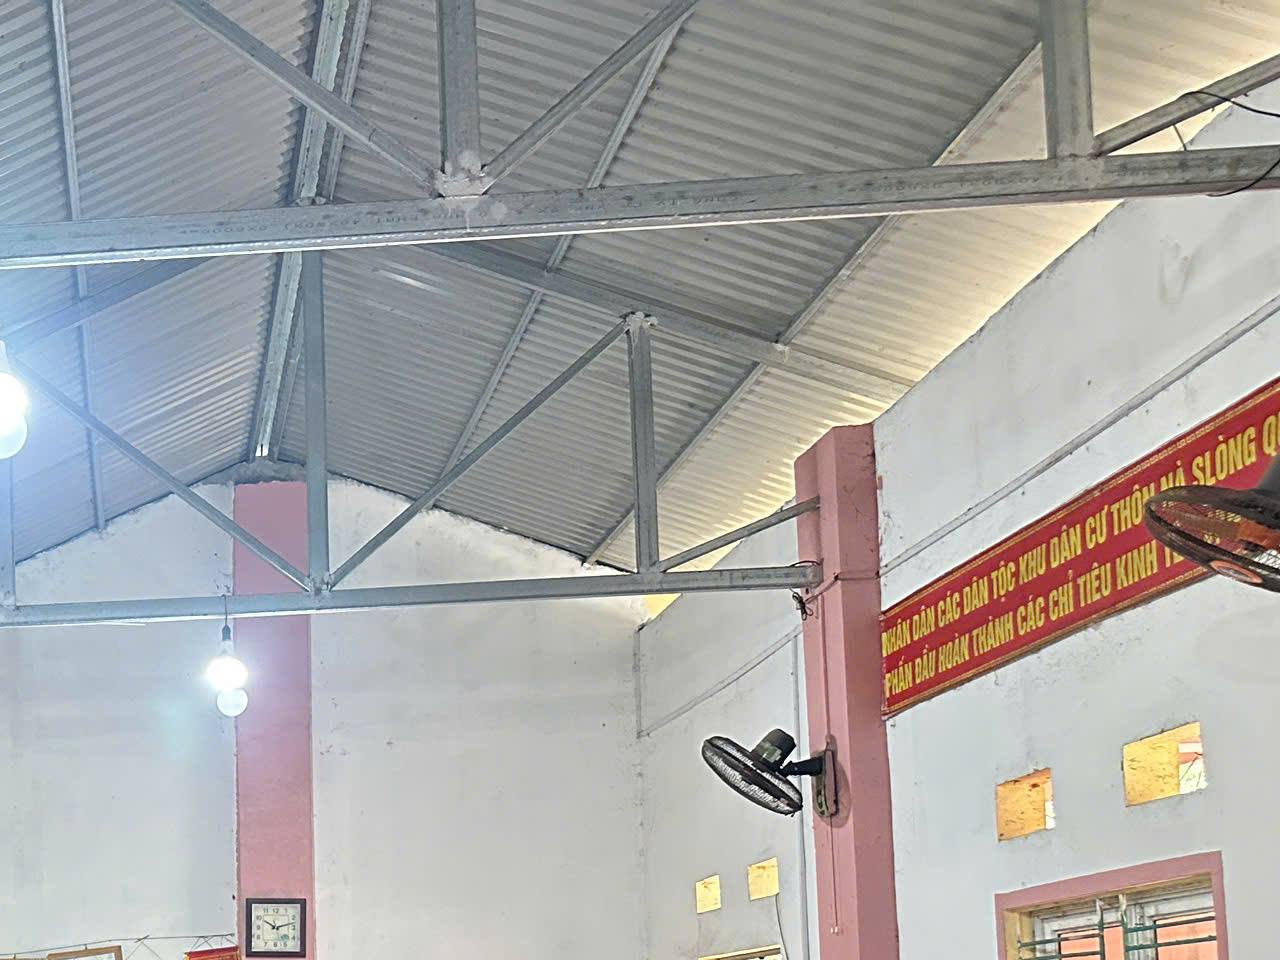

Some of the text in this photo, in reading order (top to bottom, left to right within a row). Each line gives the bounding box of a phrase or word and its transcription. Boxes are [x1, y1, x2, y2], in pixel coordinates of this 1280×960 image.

[881, 618, 911, 657] NHÂN
[912, 605, 935, 641] DÂN
[937, 590, 961, 627] CÁC
[963, 576, 989, 615] DÂN
[991, 560, 1016, 602] TỘC
[1019, 543, 1046, 585] KHU
[1049, 523, 1081, 568] DÂN
[1085, 504, 1109, 549] CƯ
[1263, 411, 1280, 457] Q
[972, 611, 1014, 657] THÀNH
[1016, 594, 1045, 636] CÁC
[1048, 569, 1074, 621] CHỈ
[1076, 562, 1111, 608] TIÊU
[1115, 539, 1158, 590] KINH
